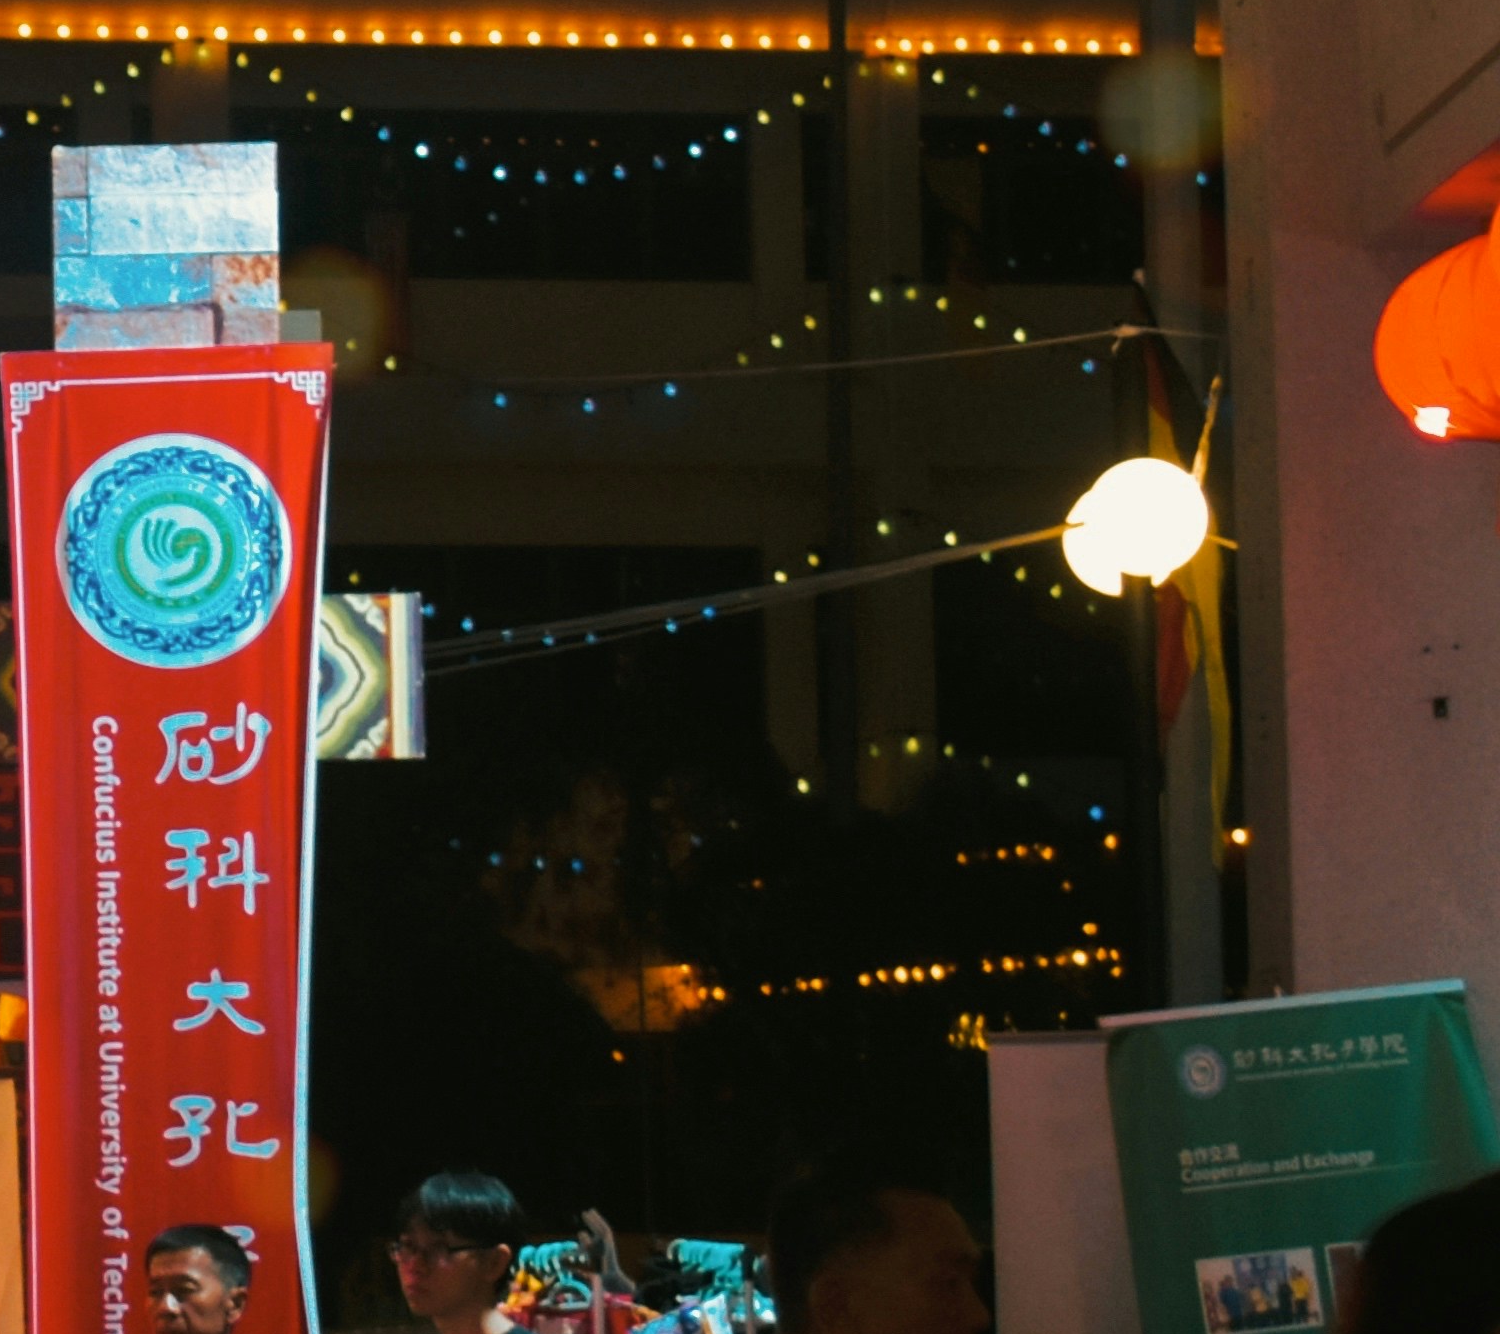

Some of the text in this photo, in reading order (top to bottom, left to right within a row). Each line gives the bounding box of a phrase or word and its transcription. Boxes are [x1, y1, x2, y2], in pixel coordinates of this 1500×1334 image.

[92, 714, 118, 864] Confucius
[96, 870, 121, 997] Institute
[99, 1004, 122, 1034] at
[96, 1041, 126, 1194] University
[1273, 1155, 1301, 1174] and
[1302, 1149, 1375, 1171] Exchange
[102, 1207, 129, 1240] of
